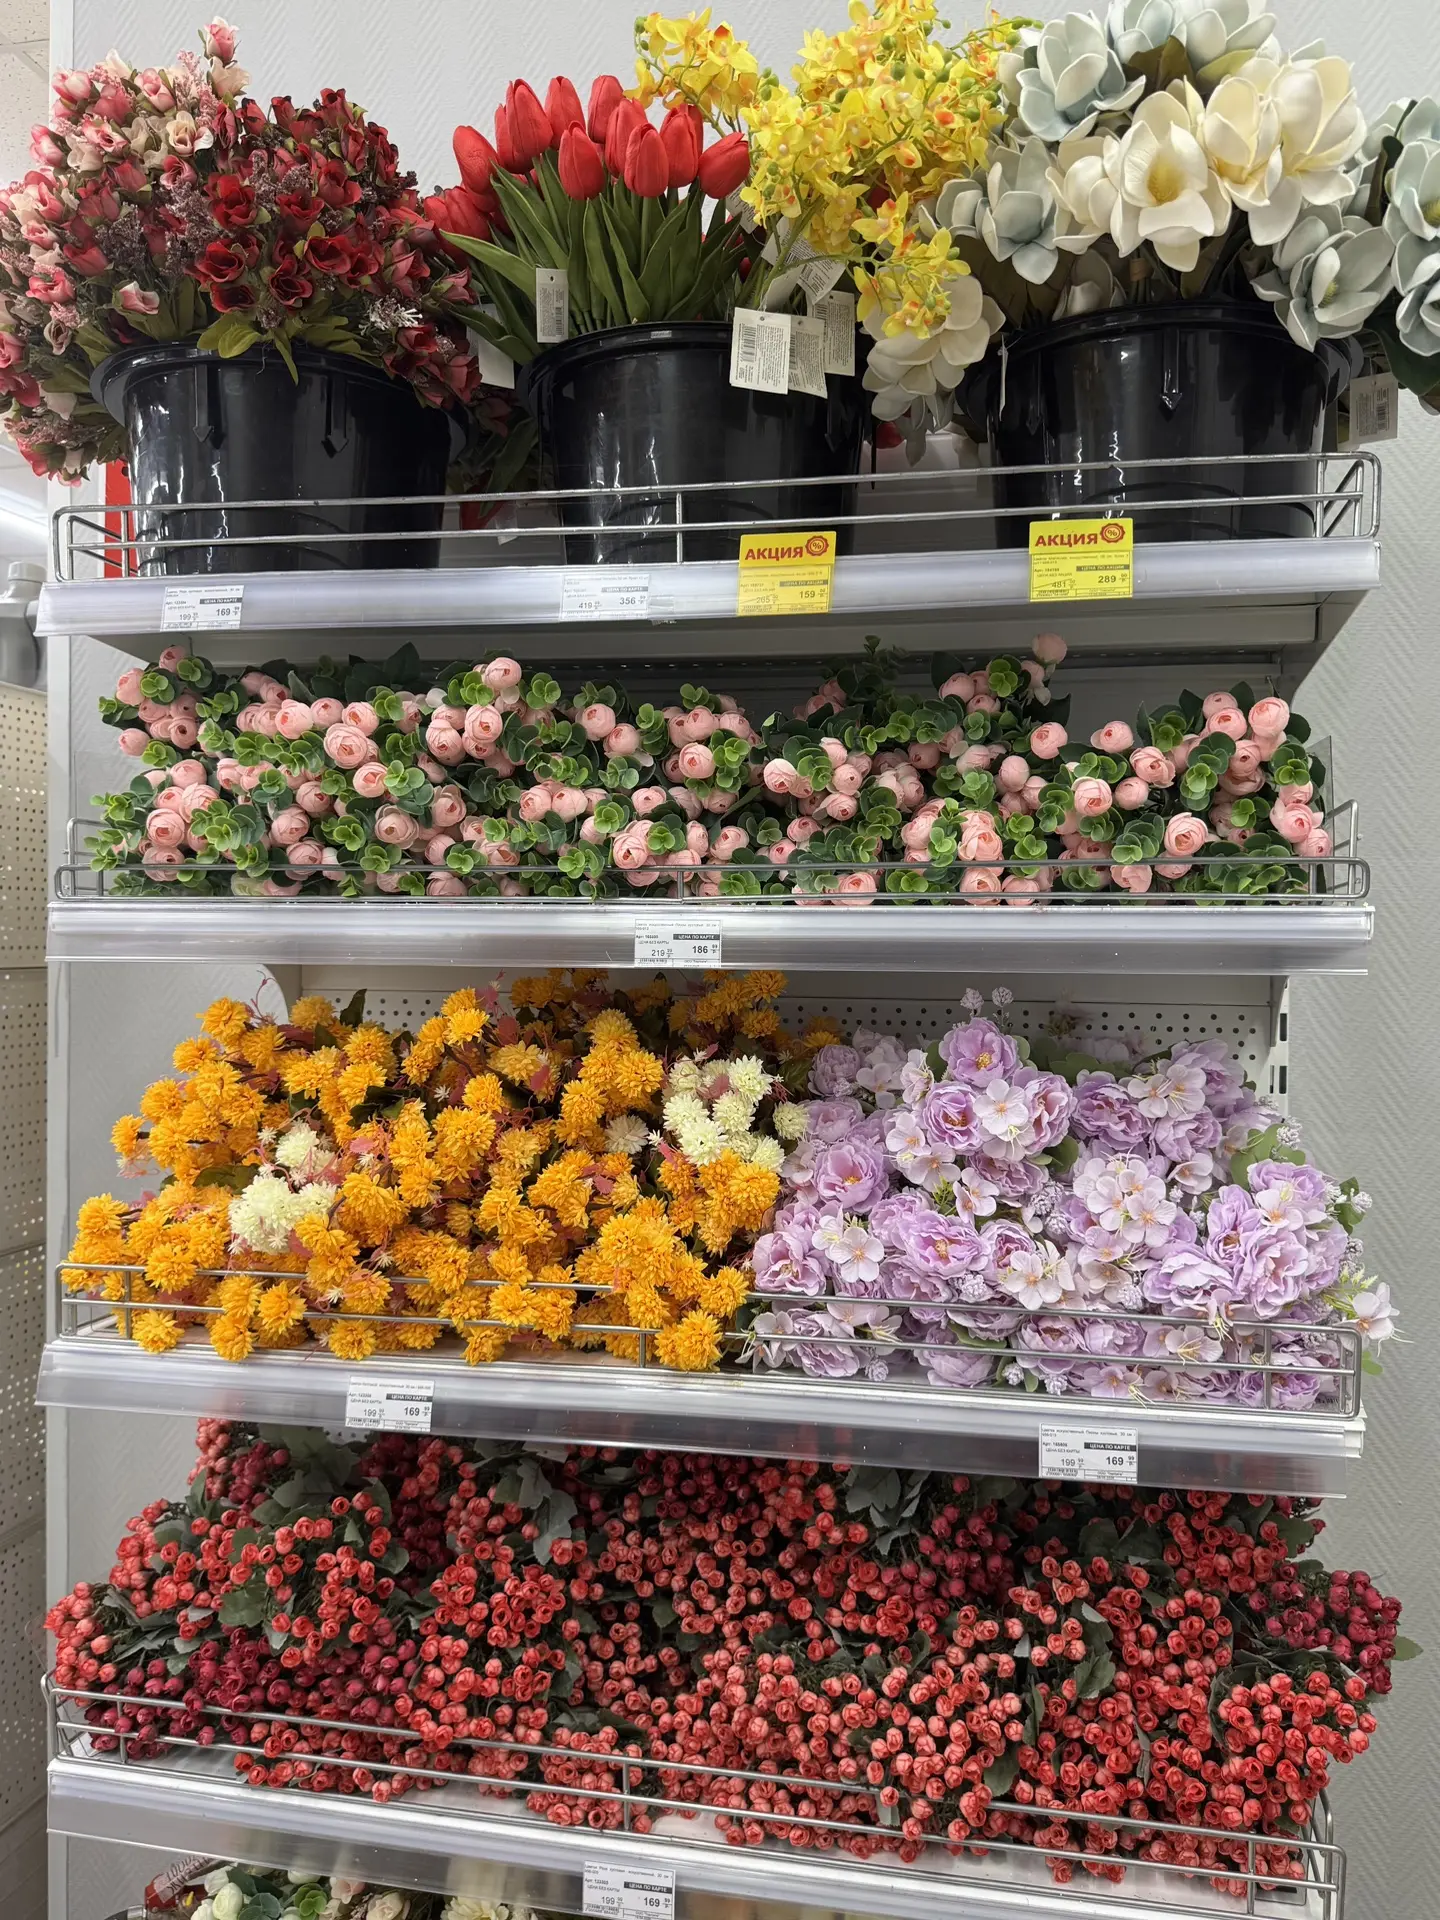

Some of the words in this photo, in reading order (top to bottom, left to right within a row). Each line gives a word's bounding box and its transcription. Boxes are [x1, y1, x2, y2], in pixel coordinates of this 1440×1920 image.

[1035, 533, 1098, 548] АКЦИЯ
[745, 547, 803, 561] АКЦИЯ
[1098, 576, 1117, 584] 289
[1052, 581, 1066, 589] 481
[800, 591, 816, 599] 159
[757, 596, 770, 604] 265
[217, 608, 231, 616] 169
[693, 946, 708, 954] 186
[364, 1409, 376, 1417] 199
[404, 1407, 420, 1416] 169
[1106, 1456, 1124, 1466] 169
[602, 1896, 615, 1905] 199
[644, 1897, 660, 1907] 169
